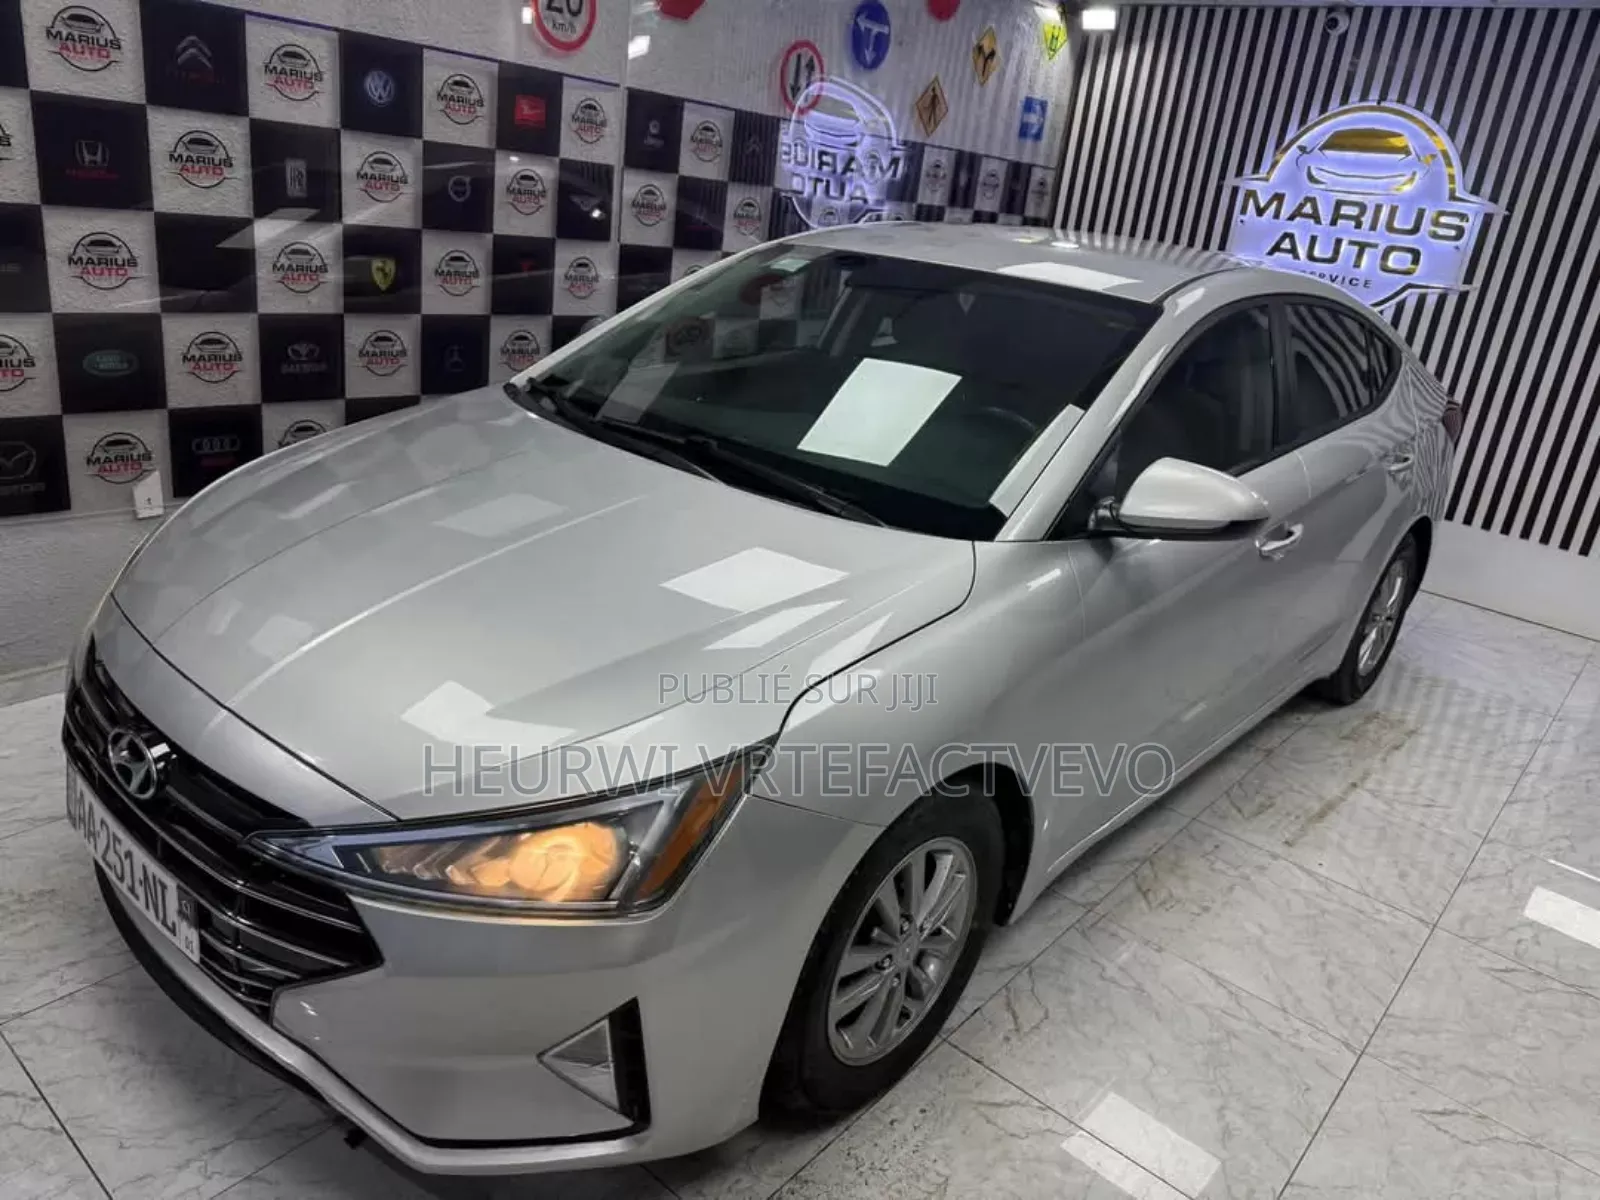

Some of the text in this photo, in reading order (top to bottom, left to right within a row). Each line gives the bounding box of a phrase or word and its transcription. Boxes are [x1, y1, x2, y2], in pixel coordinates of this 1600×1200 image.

[551, 20, 577, 33] km/h
[46, 29, 121, 51] MARIUS
[59, 42, 111, 59] AUTO
[264, 65, 323, 81] MARIUS
[274, 76, 314, 89] AUTO
[437, 92, 484, 107] MARIUS
[445, 101, 477, 114] AUTO
[168, 153, 233, 168] MARIUS
[179, 164, 225, 177] AUTO
[356, 171, 409, 184] MARIUS
[365, 180, 401, 191] AUTO
[506, 185, 546, 198] MARIUS
[512, 195, 541, 205] AUTO
[1239, 188, 1470, 243] MARIUS
[1265, 231, 1423, 276] AUTO
[67, 256, 139, 268] MARIUS
[80, 267, 129, 277] AUTO
[271, 263, 329, 274] MARIUS
[435, 269, 479, 279] MARIUS
[281, 273, 319, 282] AUTO
[441, 277, 473, 285] AUTO
[1301, 270, 1373, 288] RVICE
[182, 353, 243, 363] MARIUS
[358, 350, 407, 358] MARIUS
[0, 358, 37, 369] IUS
[192, 362, 235, 371] AUTO
[366, 357, 401, 365] AUTO
[0, 368, 25, 378] TO
[86, 453, 153, 467] MARIUS
[98, 461, 142, 473] AUTO
